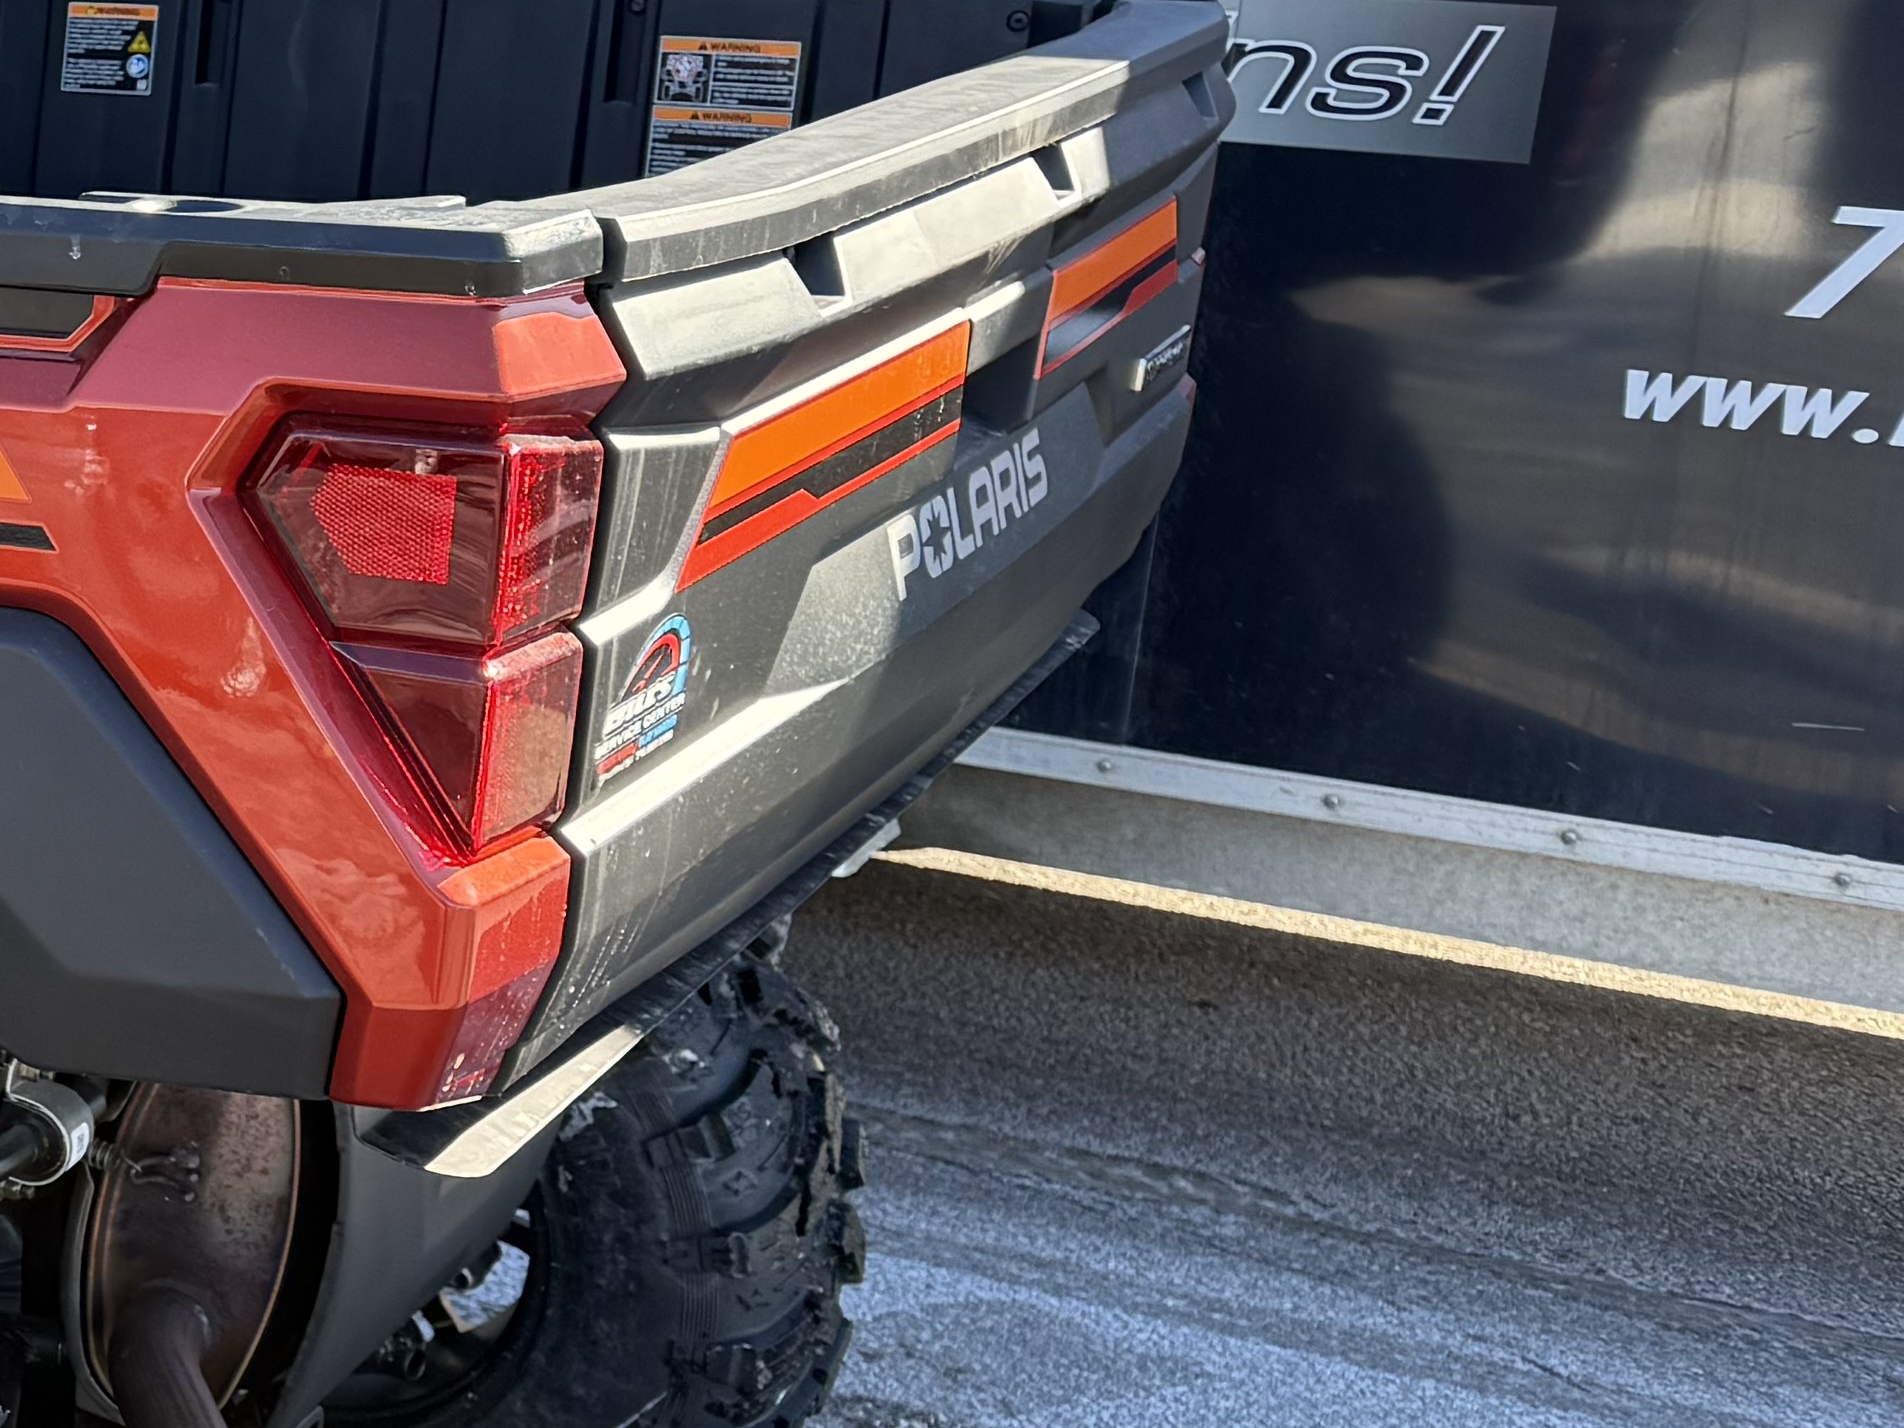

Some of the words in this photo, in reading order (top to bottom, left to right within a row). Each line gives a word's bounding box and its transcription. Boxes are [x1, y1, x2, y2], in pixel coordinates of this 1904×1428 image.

[711, 42, 761, 53] WARNING
[1221, 10, 1506, 125] ns!
[703, 112, 752, 123] WARNING
[1623, 368, 1904, 448] www.
[887, 427, 1049, 602] POLARIS
